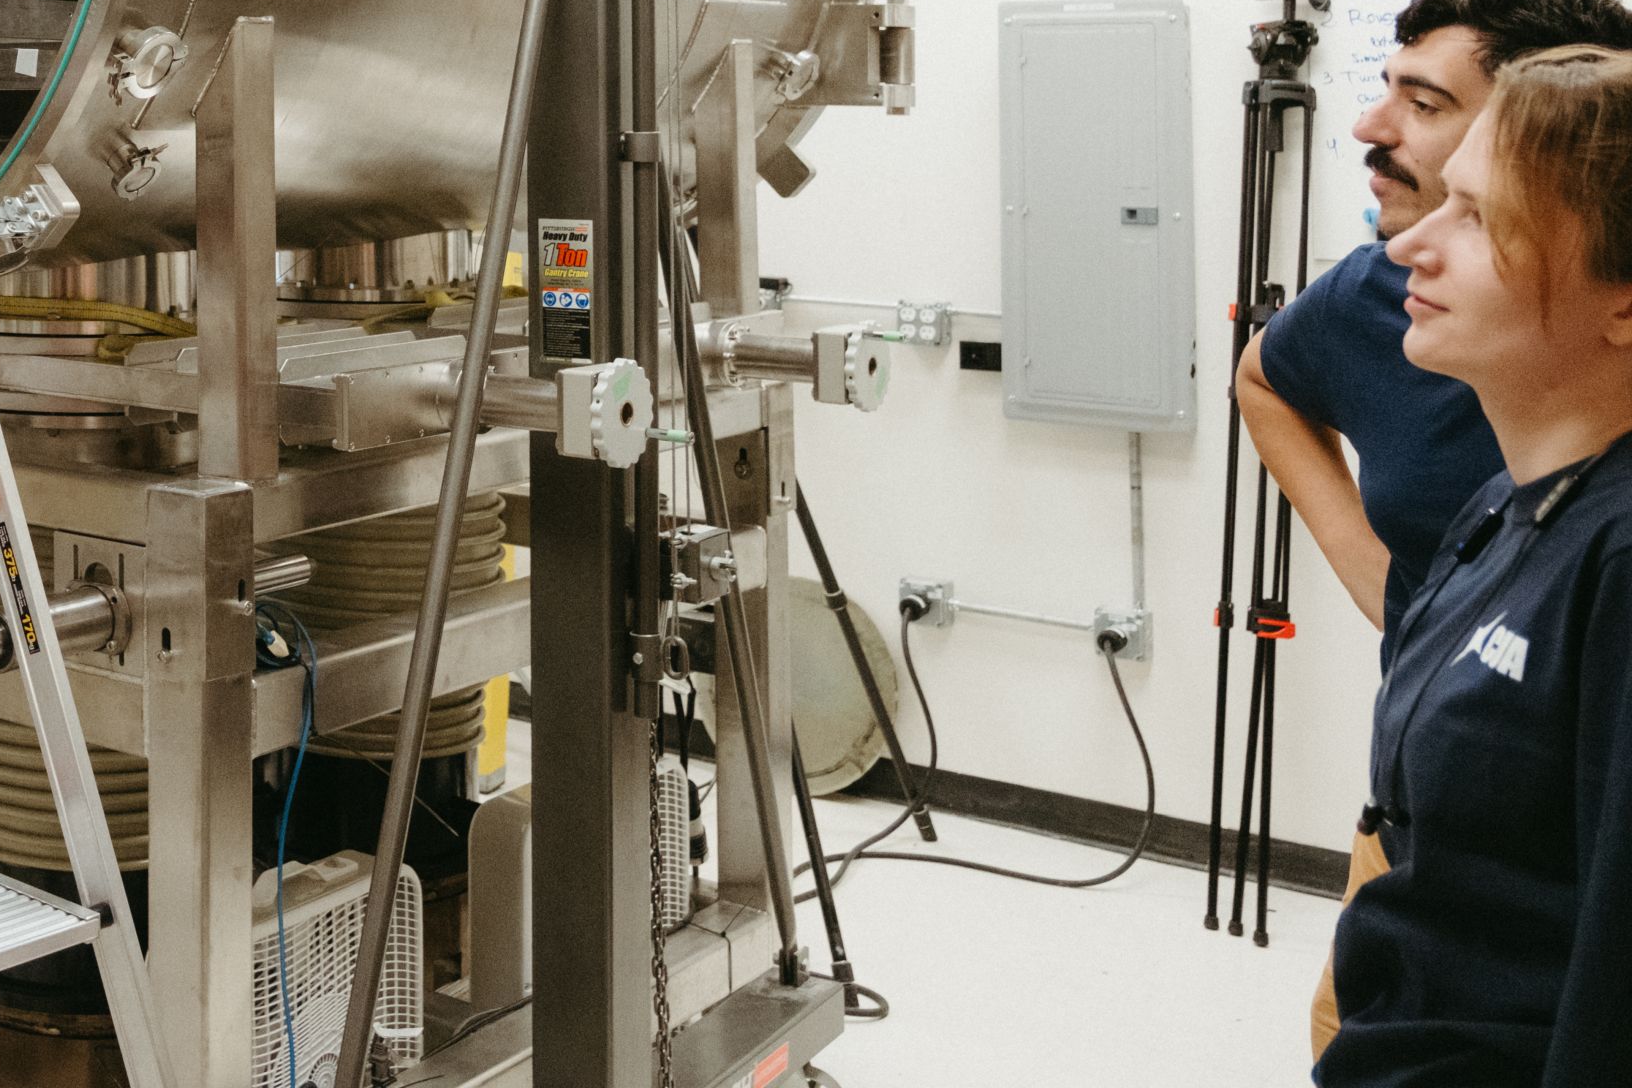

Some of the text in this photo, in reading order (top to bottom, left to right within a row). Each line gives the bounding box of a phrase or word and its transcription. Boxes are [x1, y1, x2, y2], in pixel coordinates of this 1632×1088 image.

[542, 231, 588, 243] Heavy Duty
[543, 242, 589, 268] 1 Ton
[544, 268, 589, 279] Gantry Crane
